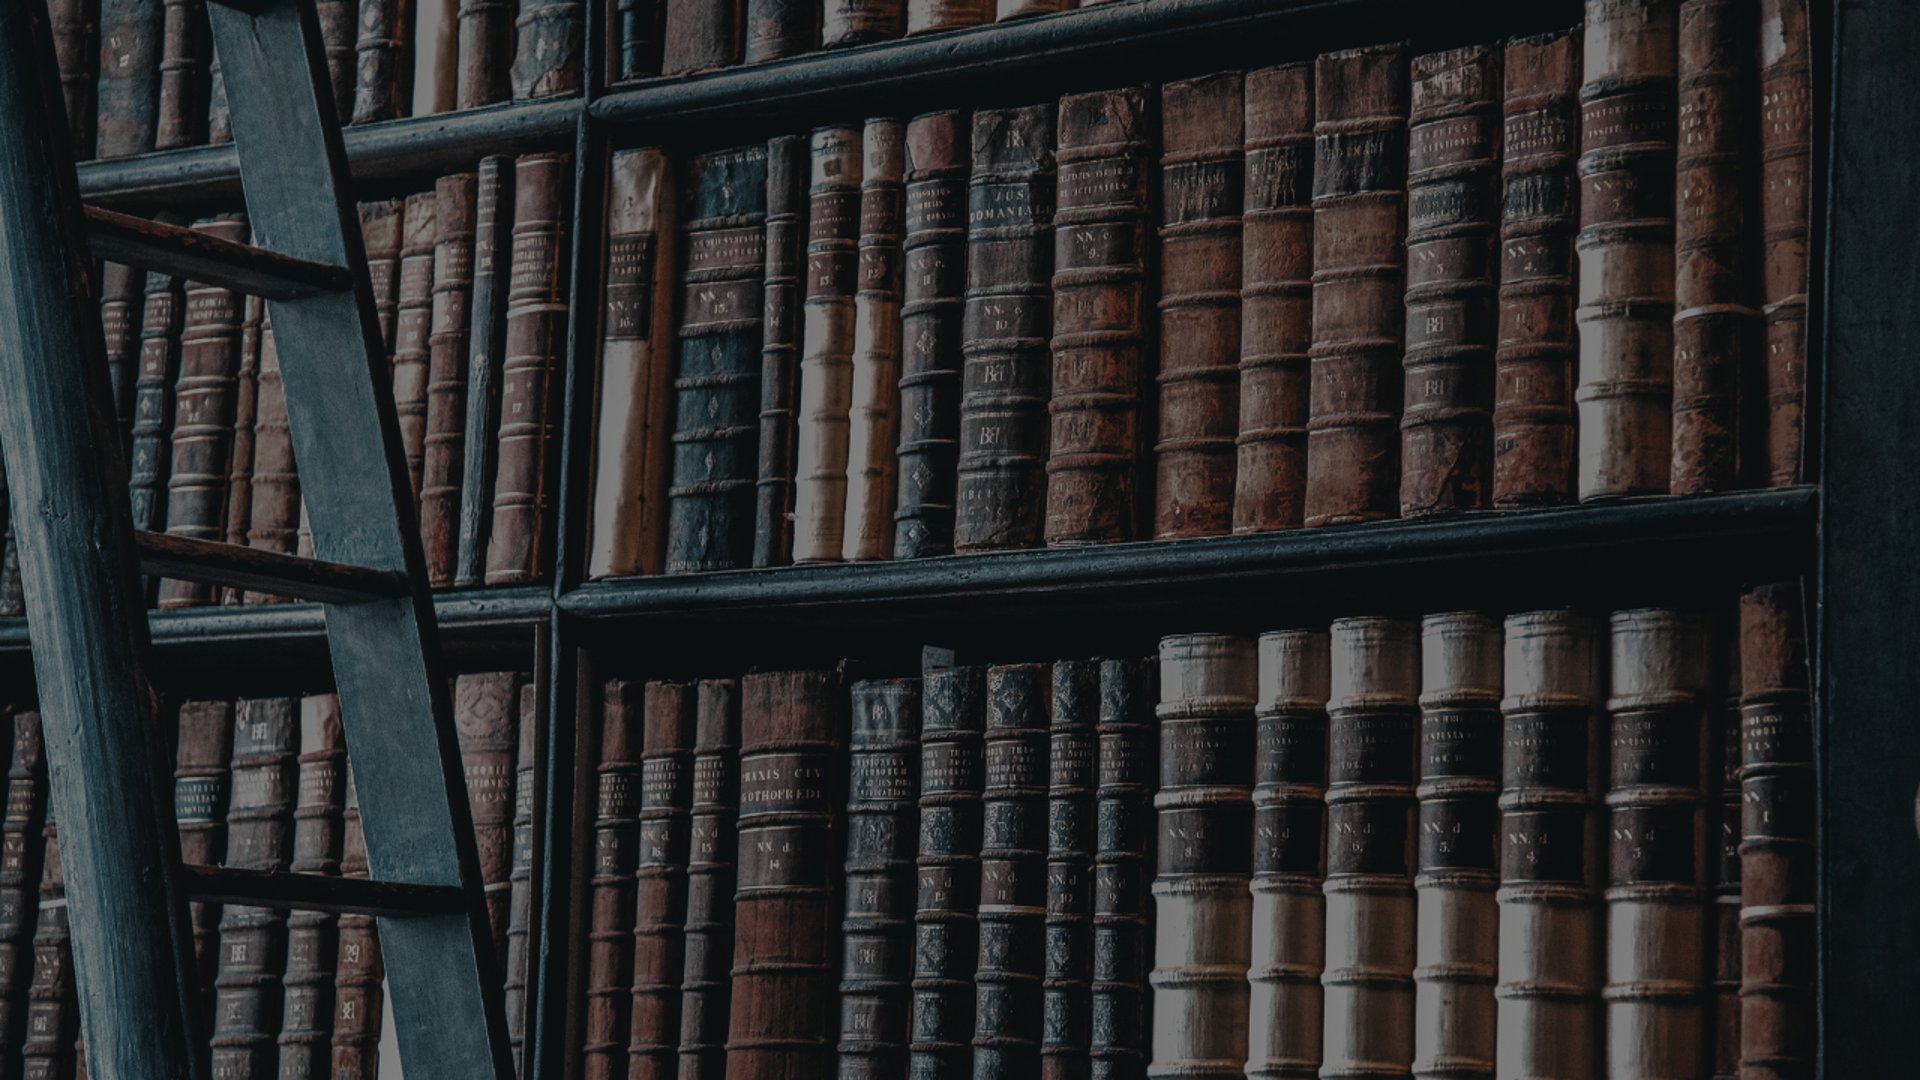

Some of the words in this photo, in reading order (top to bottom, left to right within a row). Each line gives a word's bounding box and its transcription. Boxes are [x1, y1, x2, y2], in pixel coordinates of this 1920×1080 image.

[993, 189, 1025, 203] JUS
[1088, 248, 1101, 260] 9.
[743, 768, 780, 783] RAXIS
